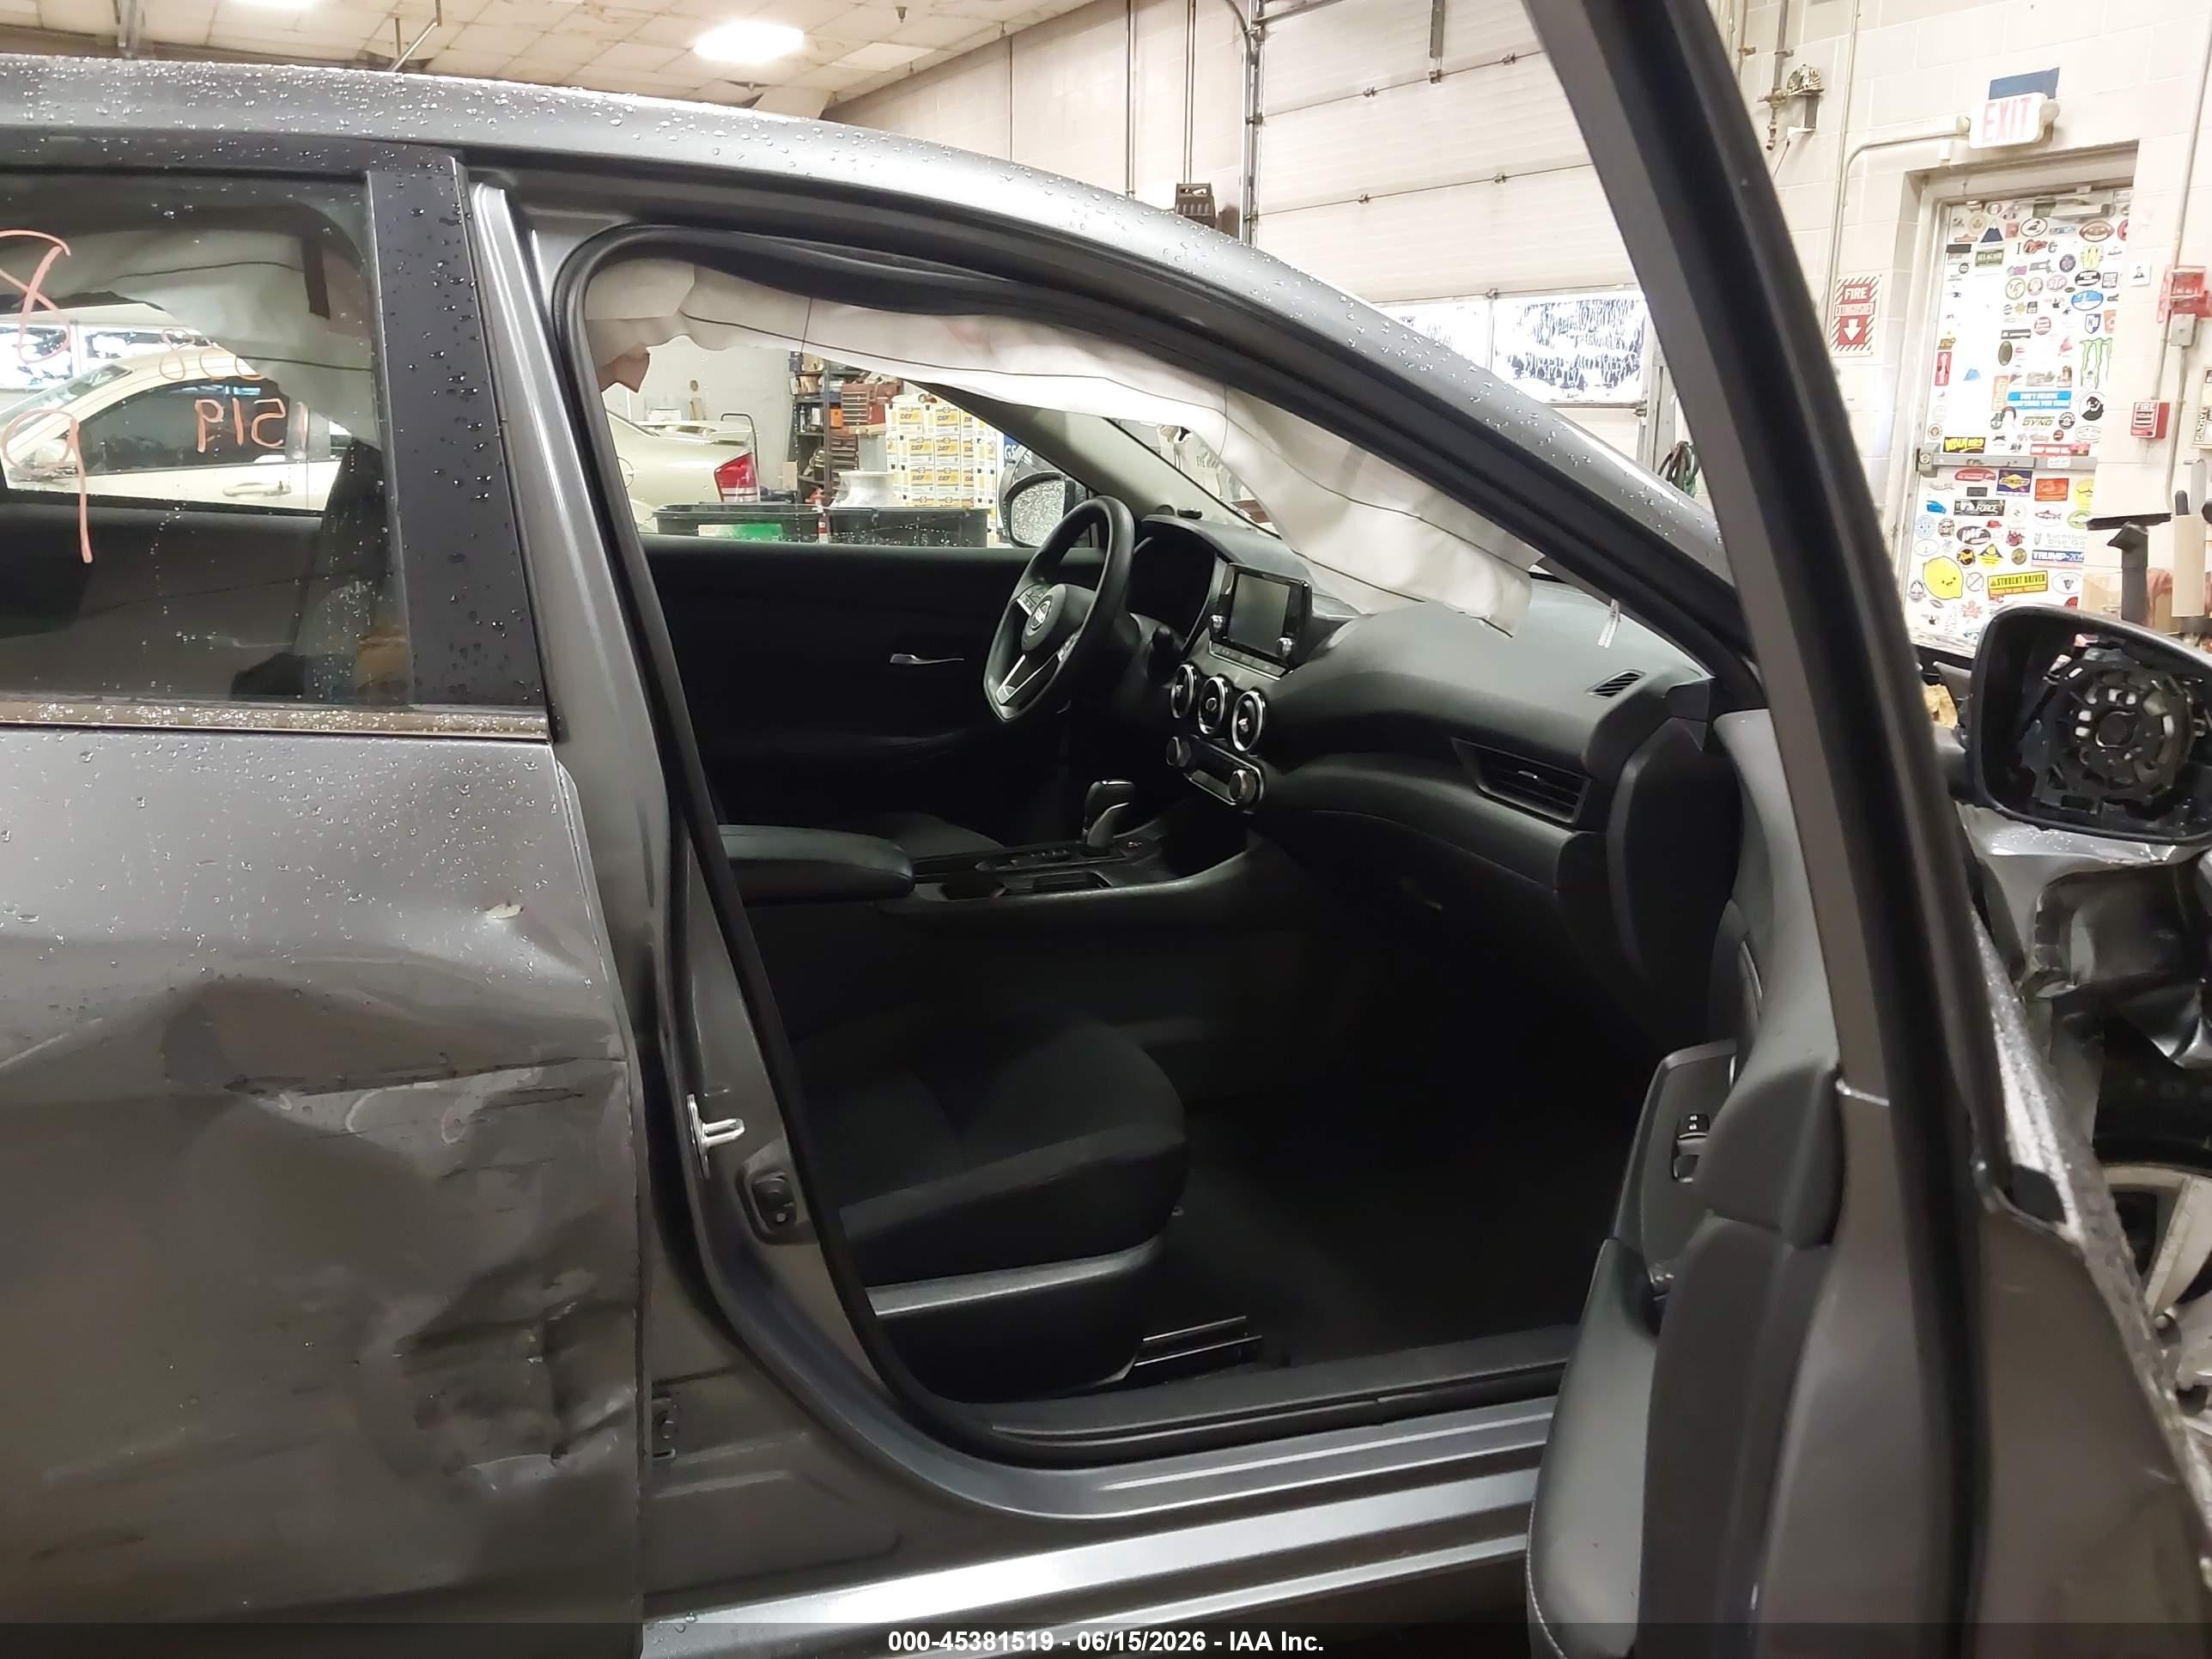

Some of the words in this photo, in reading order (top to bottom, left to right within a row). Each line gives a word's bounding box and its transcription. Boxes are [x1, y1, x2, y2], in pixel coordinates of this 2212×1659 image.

[1982, 98, 2032, 143] EXIT
[2048, 277, 2066, 289] STP
[1844, 287, 1868, 300] FIRE
[1977, 504, 1999, 513] FORCE
[2033, 550, 2067, 562] TRUMP
[1997, 575, 2023, 586] STUDENT
[2024, 574, 2045, 584] DRIVER
